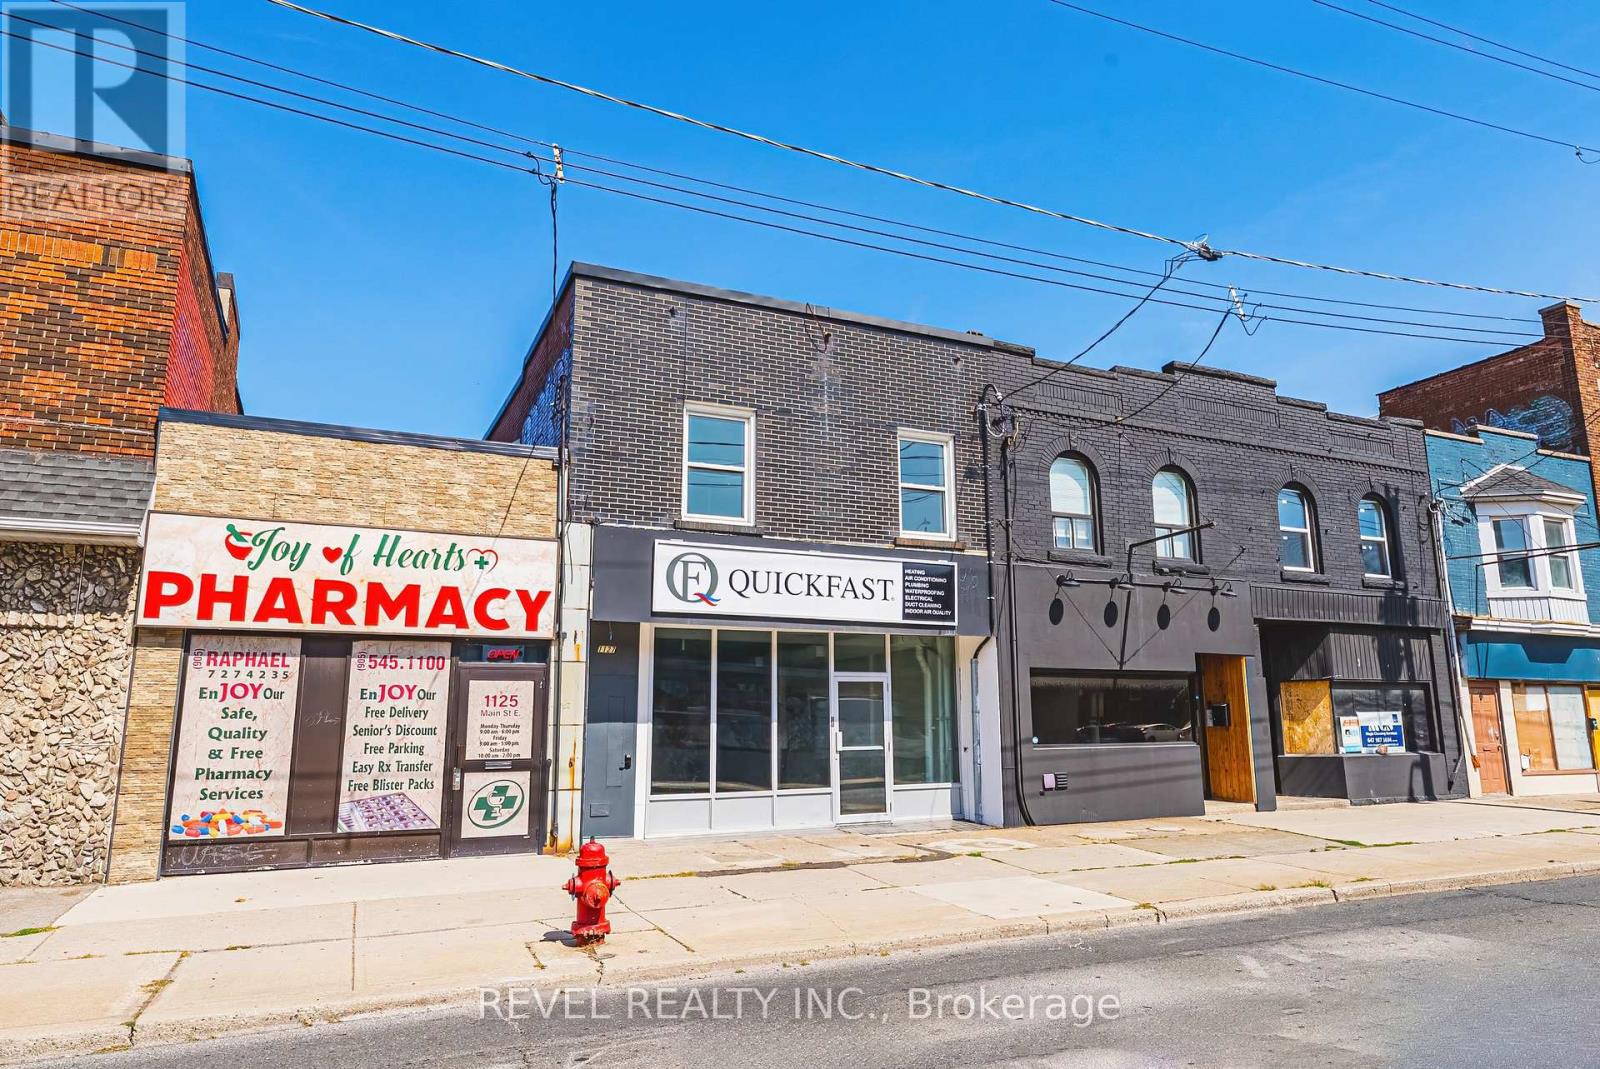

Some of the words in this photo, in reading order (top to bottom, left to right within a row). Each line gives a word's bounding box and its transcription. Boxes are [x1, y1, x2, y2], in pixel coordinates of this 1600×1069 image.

[247, 527, 311, 570] Joy
[372, 534, 467, 571] Hearts
[728, 568, 894, 602] QUICKFAST
[904, 588, 945, 596] WATERPROOFING
[142, 570, 551, 631] PHARMACY
[193, 648, 205, 670] (905)
[206, 650, 290, 668] RAPHAEL
[357, 651, 367, 671] (905)
[488, 649, 519, 659] OPEN
[368, 654, 445, 670] 545.1100
[199, 682, 263, 702] EnJOY
[263, 688, 285, 700] Our
[360, 684, 418, 702] EnJOY
[418, 688, 436, 700] Our
[484, 694, 519, 707] 1125
[221, 707, 257, 721] Safe,
[365, 706, 386, 718] Free
[389, 706, 429, 720] Delivery
[480, 709, 500, 717] Main
[503, 709, 512, 717] St
[513, 709, 521, 717] E.
[208, 727, 268, 742] Quality
[352, 724, 391, 737] Senior's
[395, 724, 437, 736] Discount
[208, 749, 223, 759] &
[230, 747, 263, 760] Free
[364, 743, 384, 754] Free
[388, 742, 425, 755] Parking
[195, 767, 272, 781] Pharmacy
[352, 761, 374, 775] Easy
[378, 761, 391, 772] Rx
[396, 760, 433, 772] Transfer
[348, 779, 368, 792] Free
[372, 778, 404, 791] Blister
[408, 778, 434, 790] Packs
[199, 788, 263, 801] Services
